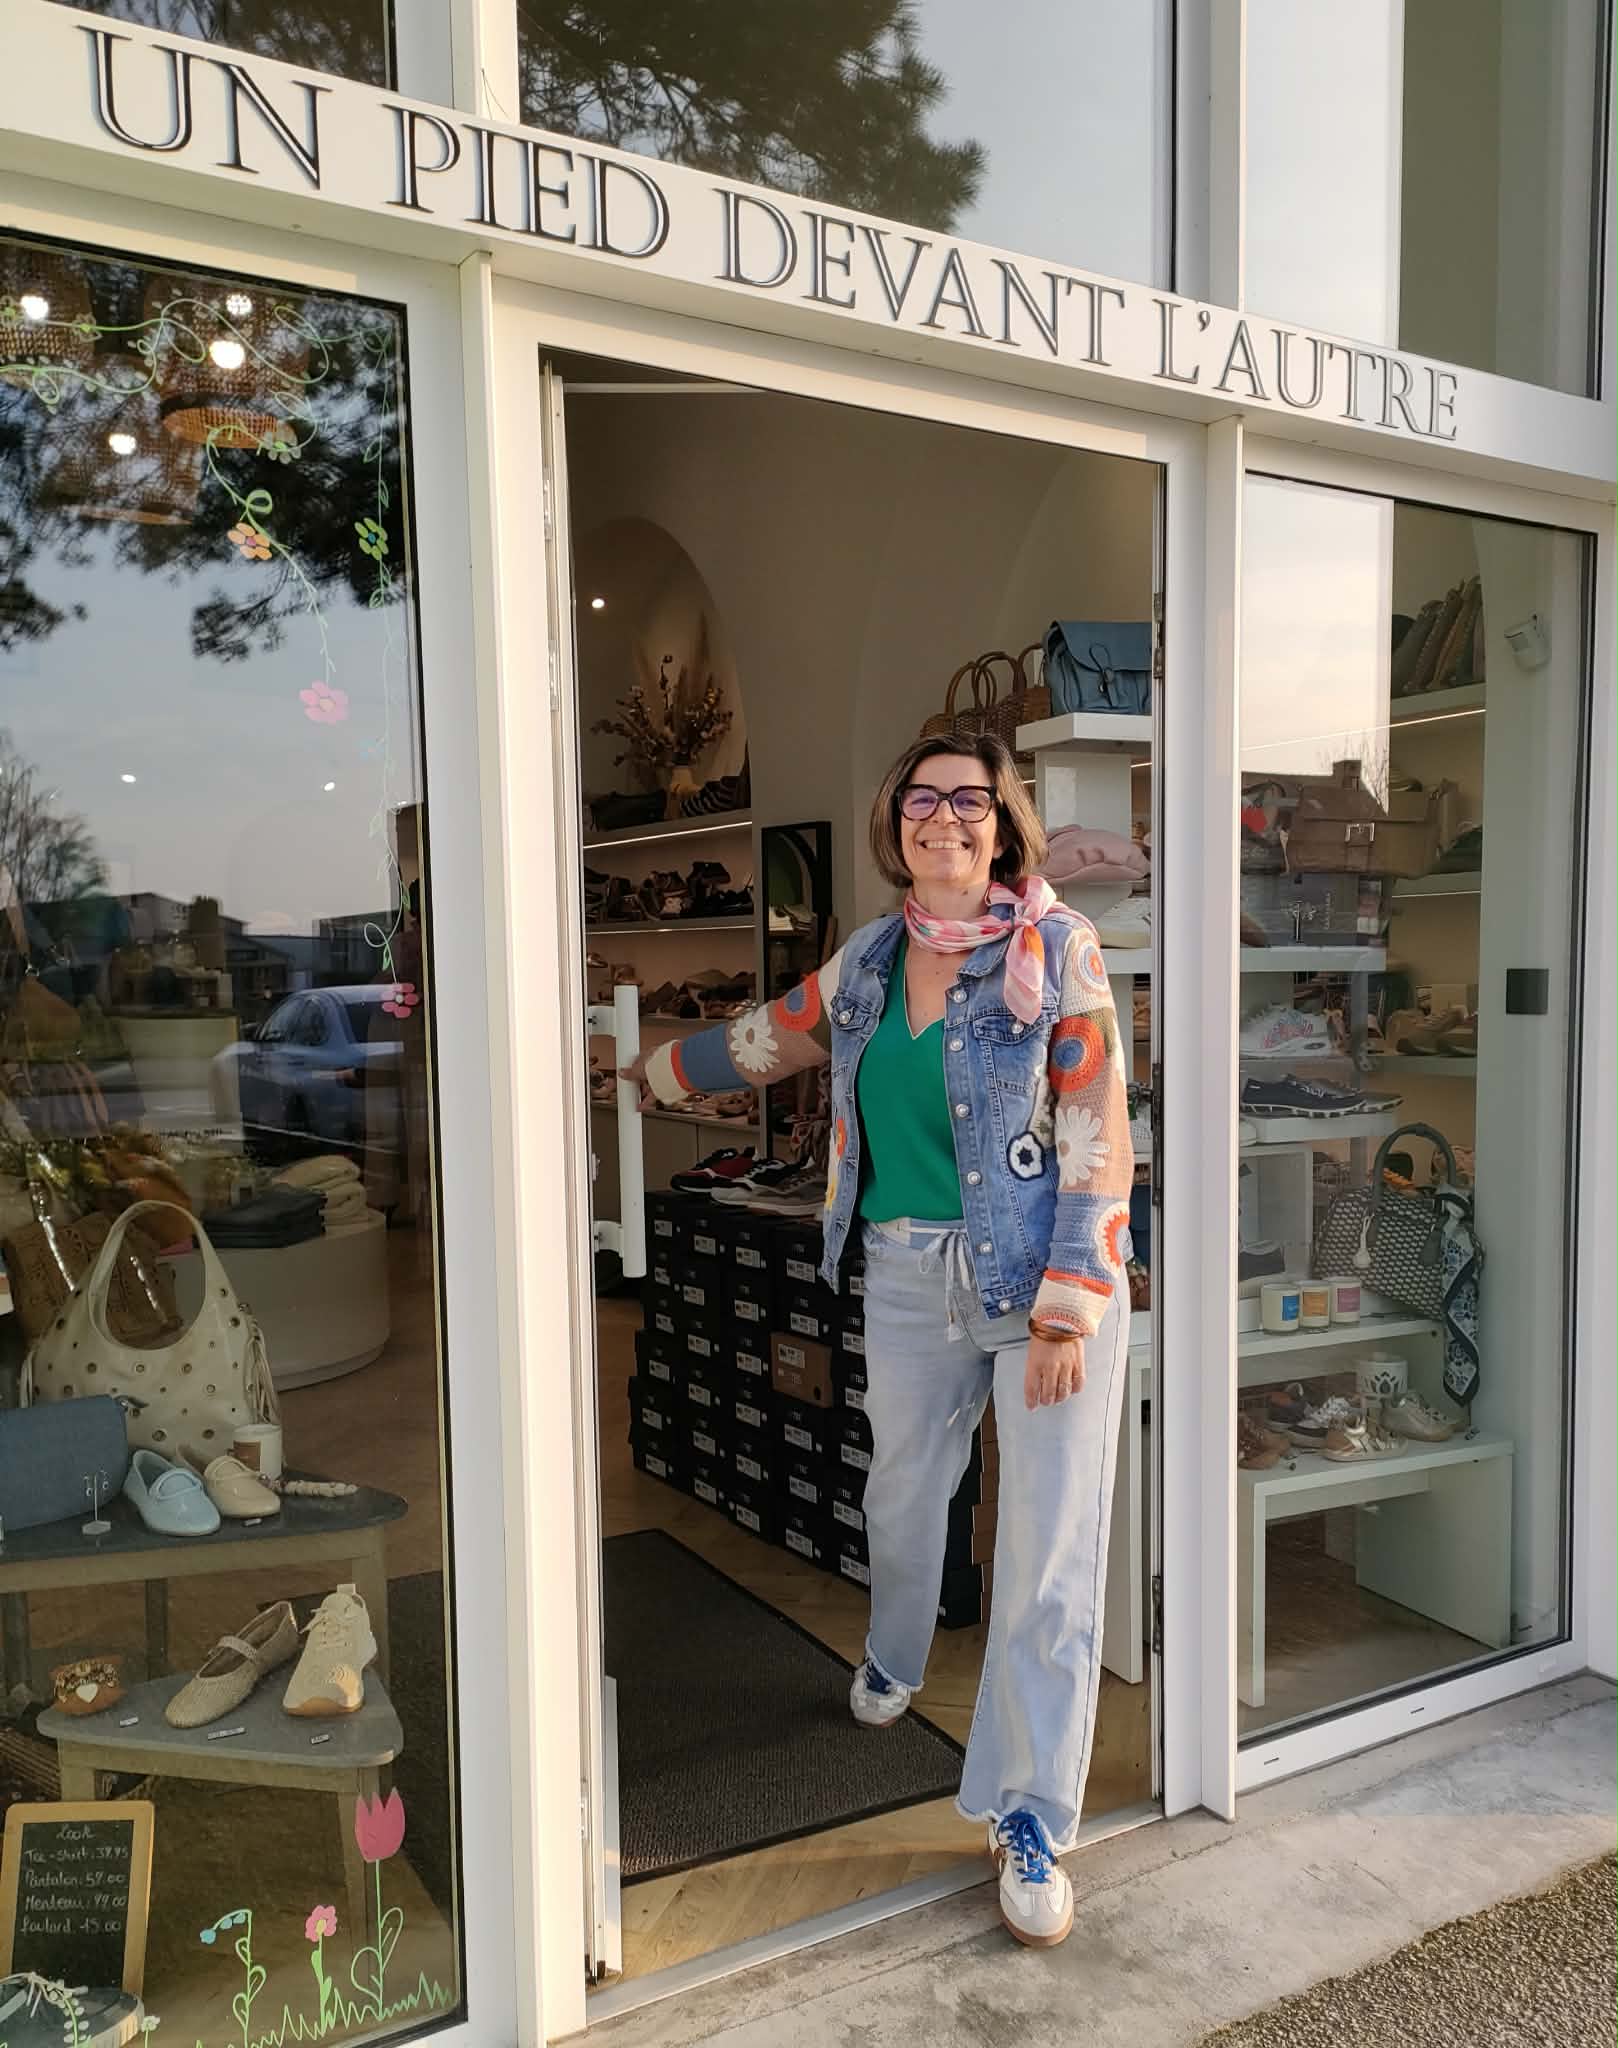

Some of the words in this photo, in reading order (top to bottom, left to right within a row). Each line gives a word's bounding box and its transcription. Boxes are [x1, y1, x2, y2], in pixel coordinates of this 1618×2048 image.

[77, 25, 333, 190] UN
[380, 103, 671, 259] PIED
[711, 187, 1126, 366] DEVANT
[1151, 297, 1459, 441] L'AUTRE
